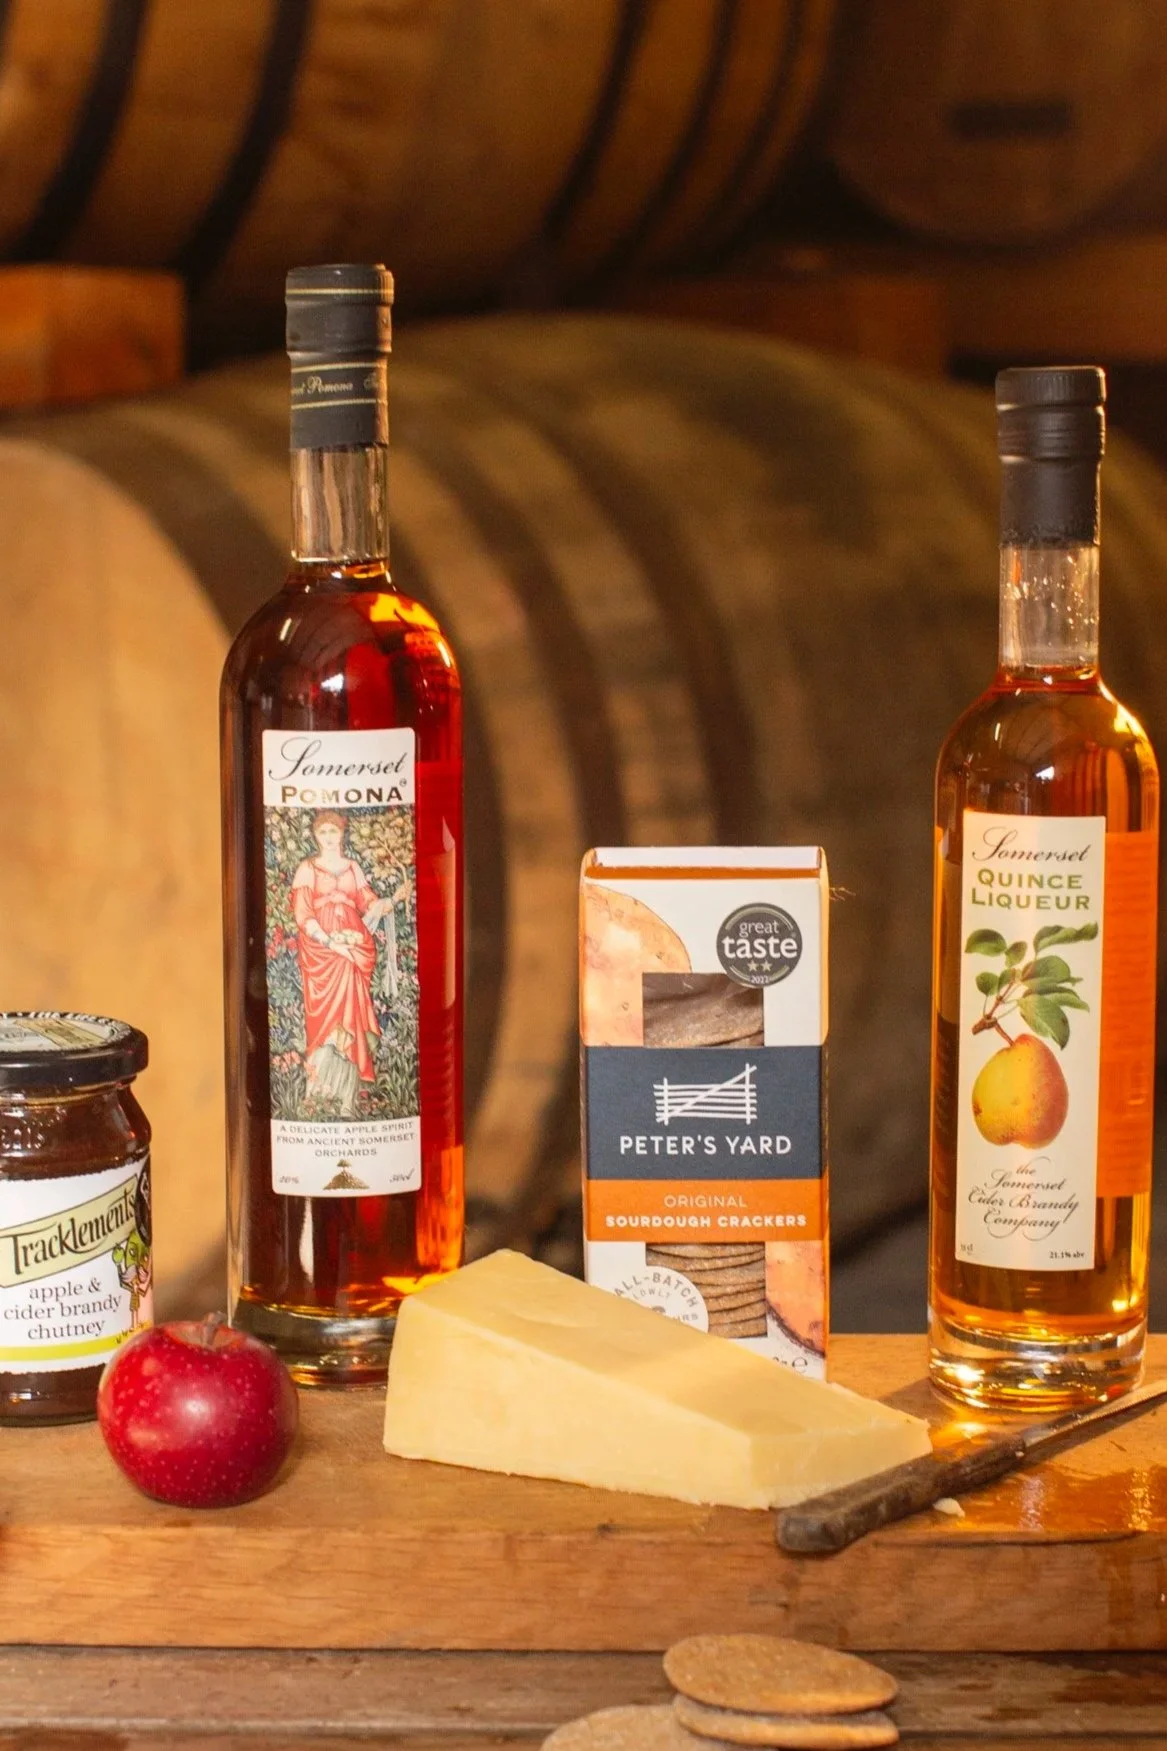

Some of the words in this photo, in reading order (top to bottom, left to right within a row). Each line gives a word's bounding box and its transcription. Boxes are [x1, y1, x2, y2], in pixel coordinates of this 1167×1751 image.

[269, 736, 407, 781] Somerset
[972, 826, 1091, 861] Somerset
[977, 868, 1082, 890] QUINCE
[971, 888, 1090, 910] LIQUEUR
[739, 920, 779, 938] great
[721, 935, 798, 958] taste
[279, 1124, 287, 1133] A
[290, 1123, 339, 1135] DELICATE
[344, 1123, 377, 1134] APPLE
[381, 1121, 413, 1133] SPIRIT
[276, 1135, 304, 1145] FROM
[307, 1136, 355, 1146] ANCIENT
[359, 1133, 415, 1145] SOMERSET
[619, 1134, 717, 1155] PETER'S
[725, 1134, 792, 1155] YARD
[314, 1148, 377, 1157] ORCHARDS
[984, 1168, 1067, 1190] Somerset
[664, 1194, 747, 1208] ORIGINAL
[968, 1186, 1005, 1206] Cider
[1009, 1193, 1079, 1224] Brandy
[0, 1187, 136, 1275] Tracklements
[605, 1215, 711, 1228] SOURDOUGH
[717, 1214, 807, 1227] CRACKERS
[983, 1207, 1061, 1242] Company
[29, 1281, 83, 1302] apple
[88, 1277, 101, 1293] &
[614, 1272, 699, 1308] ALL-BATCH
[4, 1303, 55, 1320] cider
[60, 1295, 122, 1318] brandy
[28, 1320, 105, 1340] chutney
